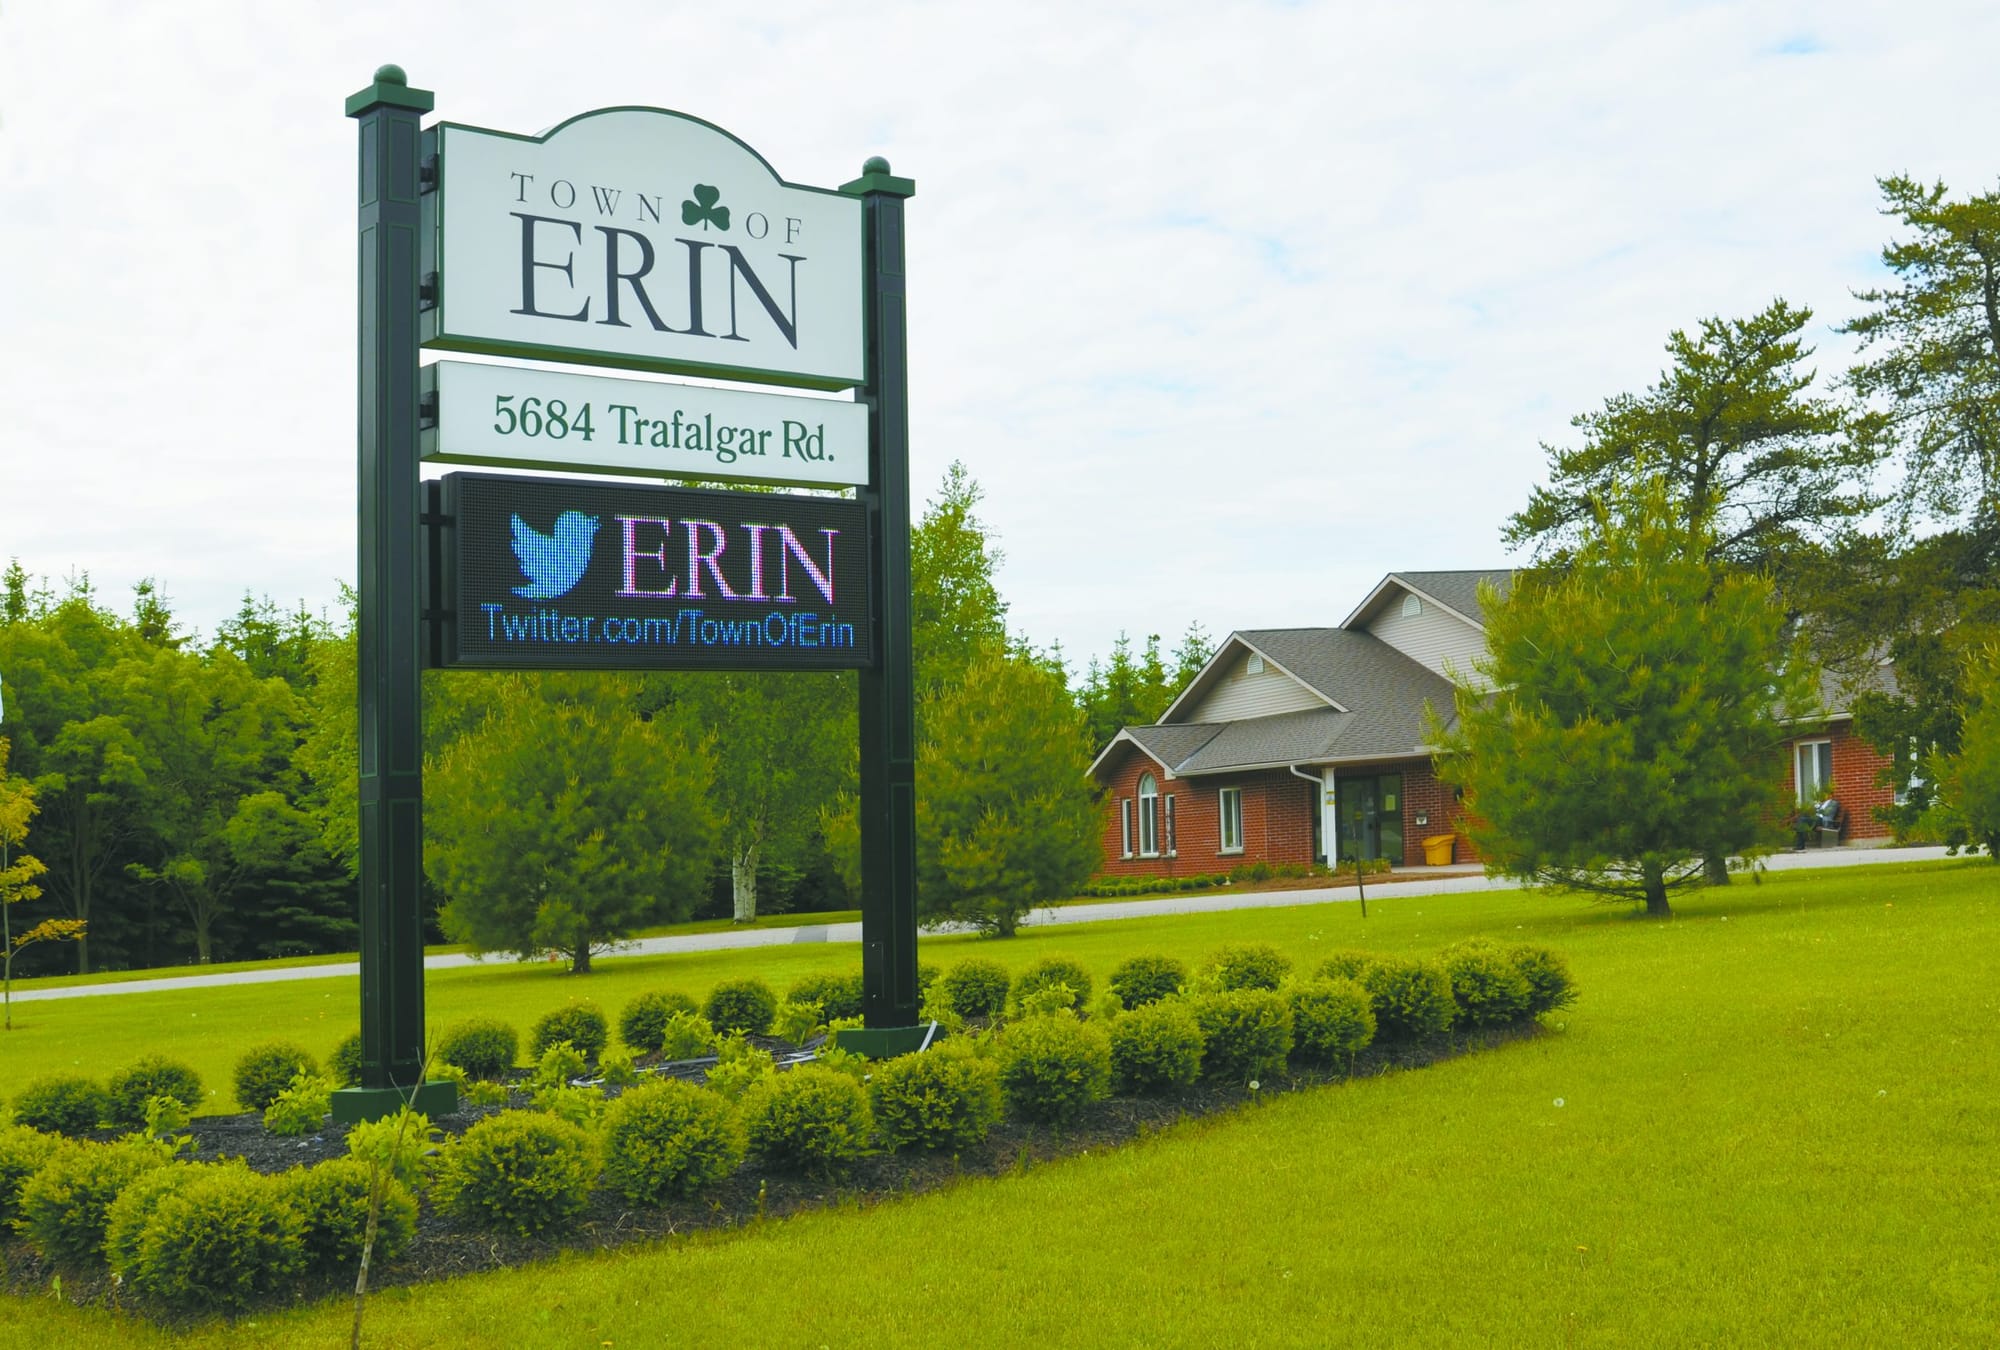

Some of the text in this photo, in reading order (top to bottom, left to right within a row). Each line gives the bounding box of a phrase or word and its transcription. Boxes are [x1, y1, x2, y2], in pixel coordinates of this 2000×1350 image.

[511, 172, 802, 244] TOWN OF
[510, 212, 806, 350] ERIN
[494, 395, 835, 463] 5684 Trafalgar Rd.
[614, 514, 840, 604] ERIN
[480, 603, 853, 648] Twitter.com/TownOfErin
